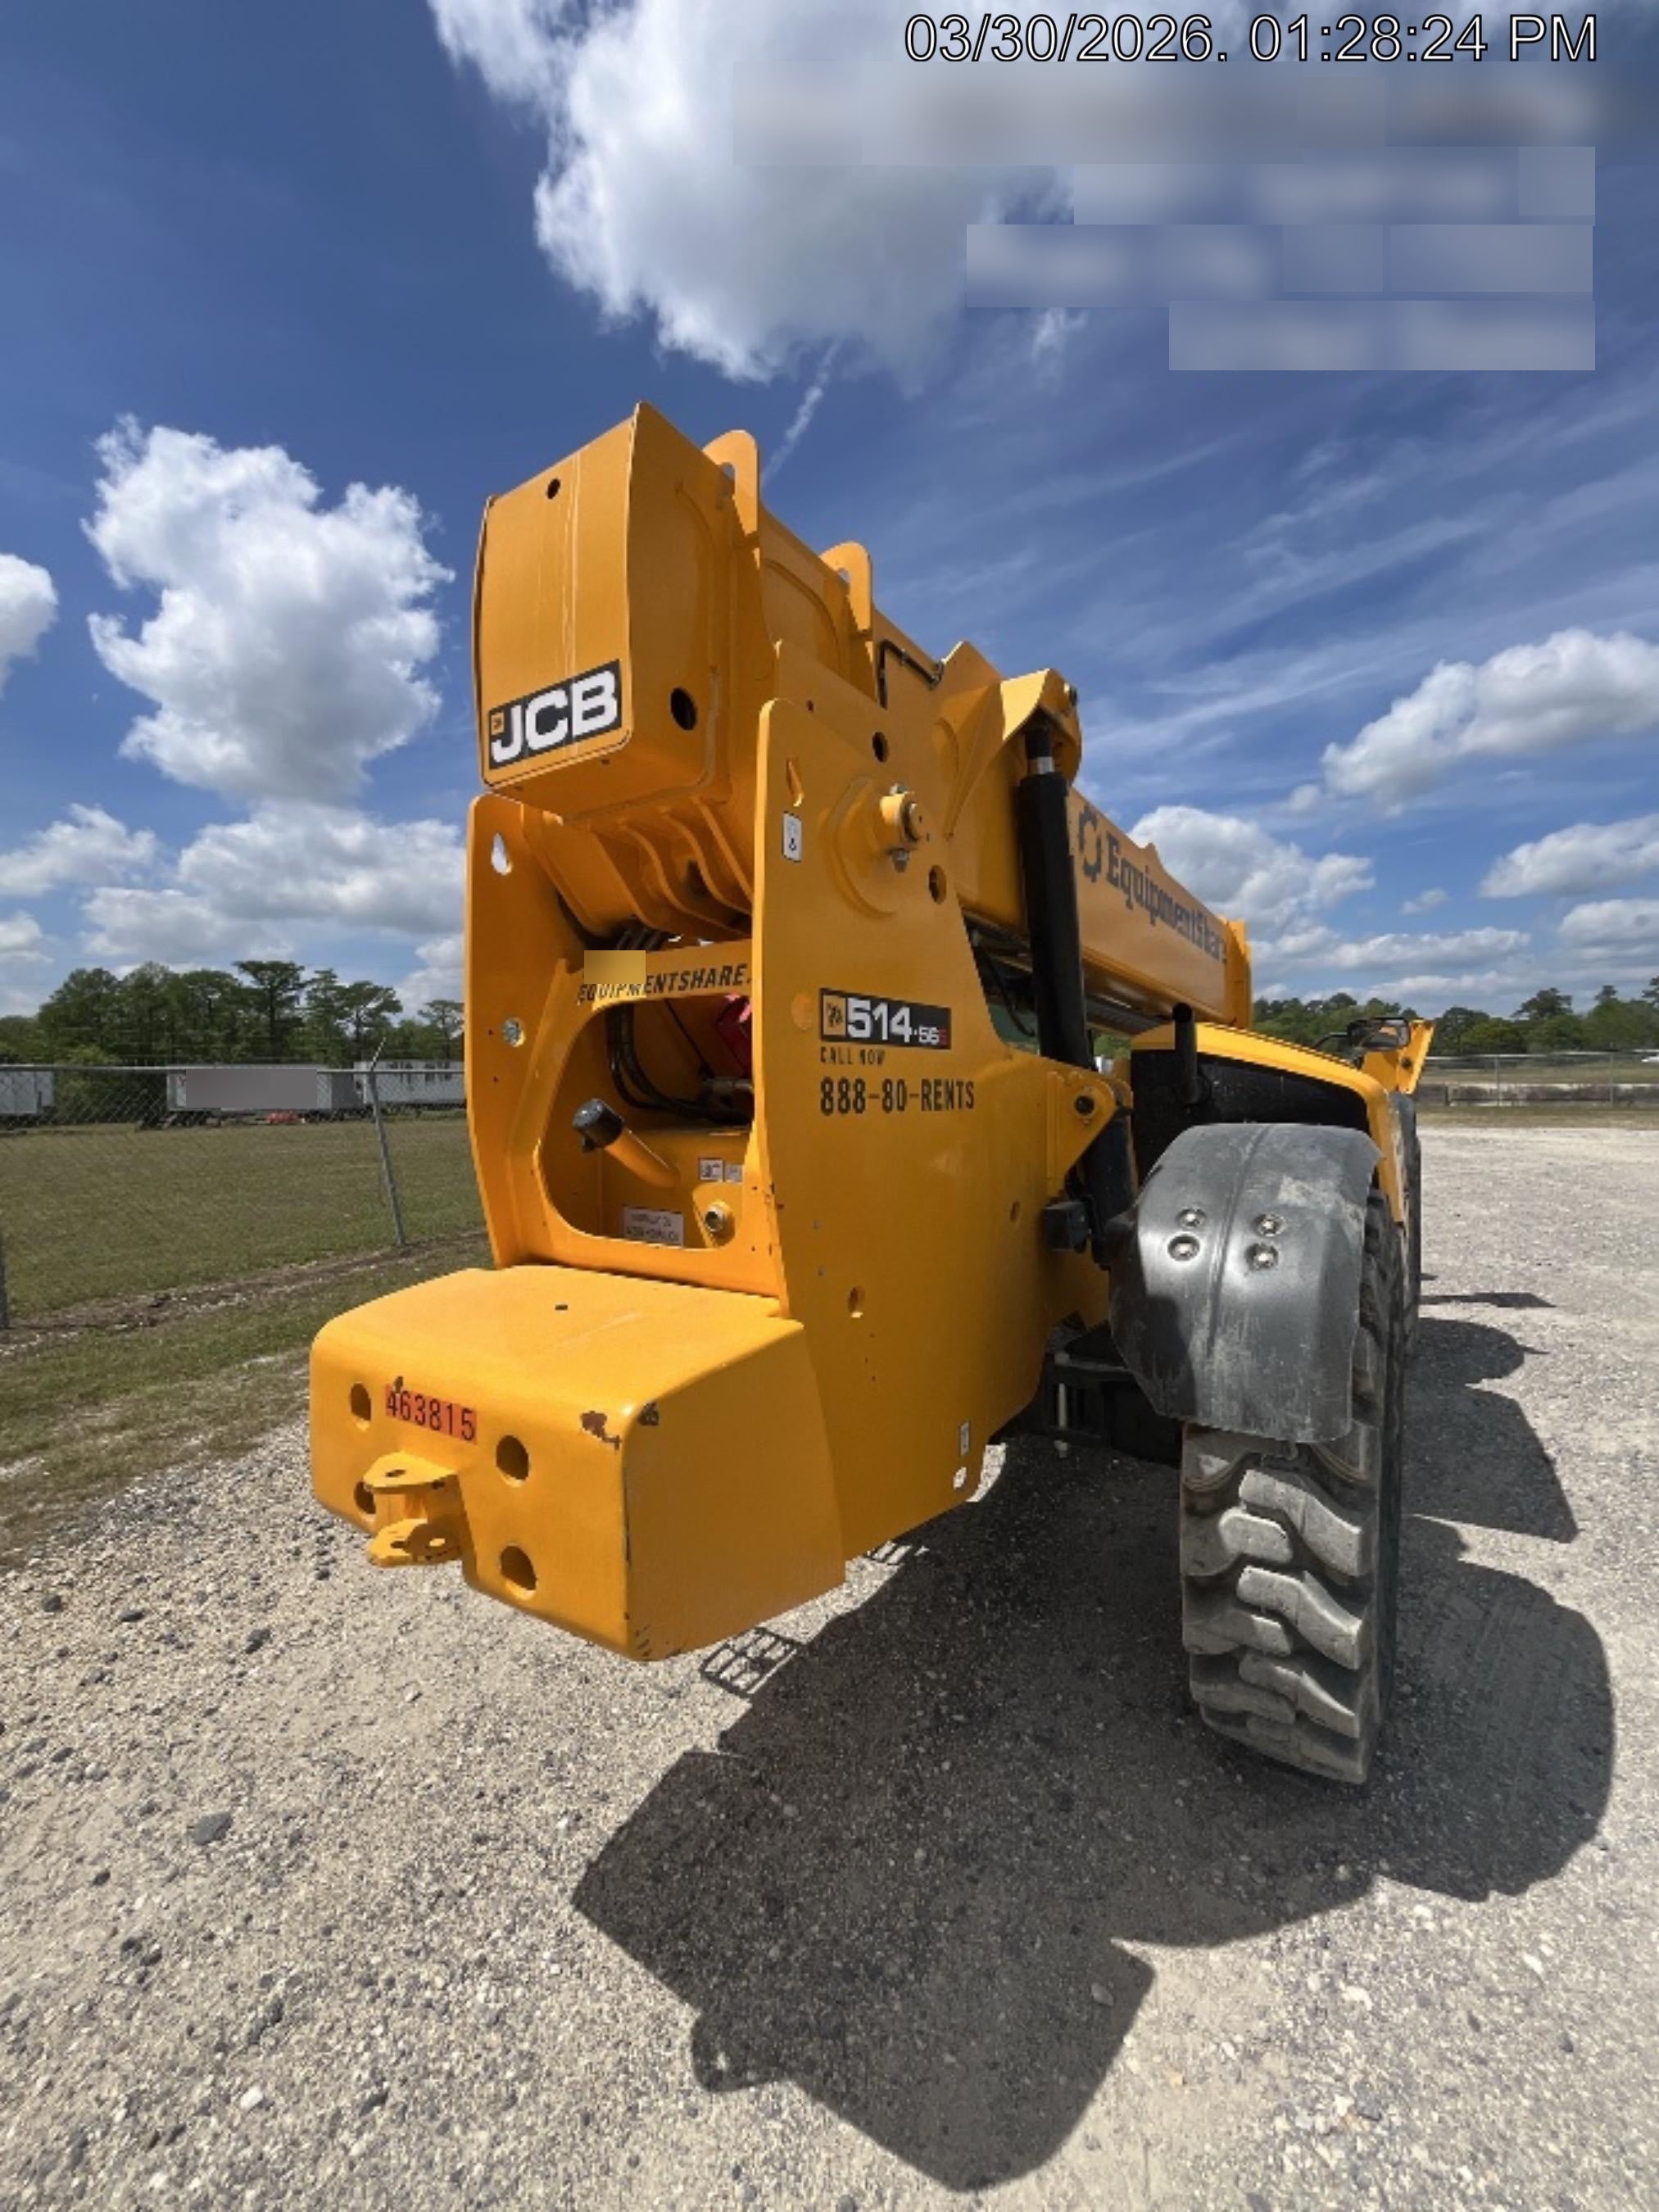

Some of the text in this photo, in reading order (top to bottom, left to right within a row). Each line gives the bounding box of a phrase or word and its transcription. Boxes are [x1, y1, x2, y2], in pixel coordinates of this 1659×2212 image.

[491, 669, 619, 763] JCB
[820, 1046, 886, 1065] CALL NOW
[820, 1076, 974, 1116] 888-80-RENTS
[387, 1390, 475, 1441] 463815
